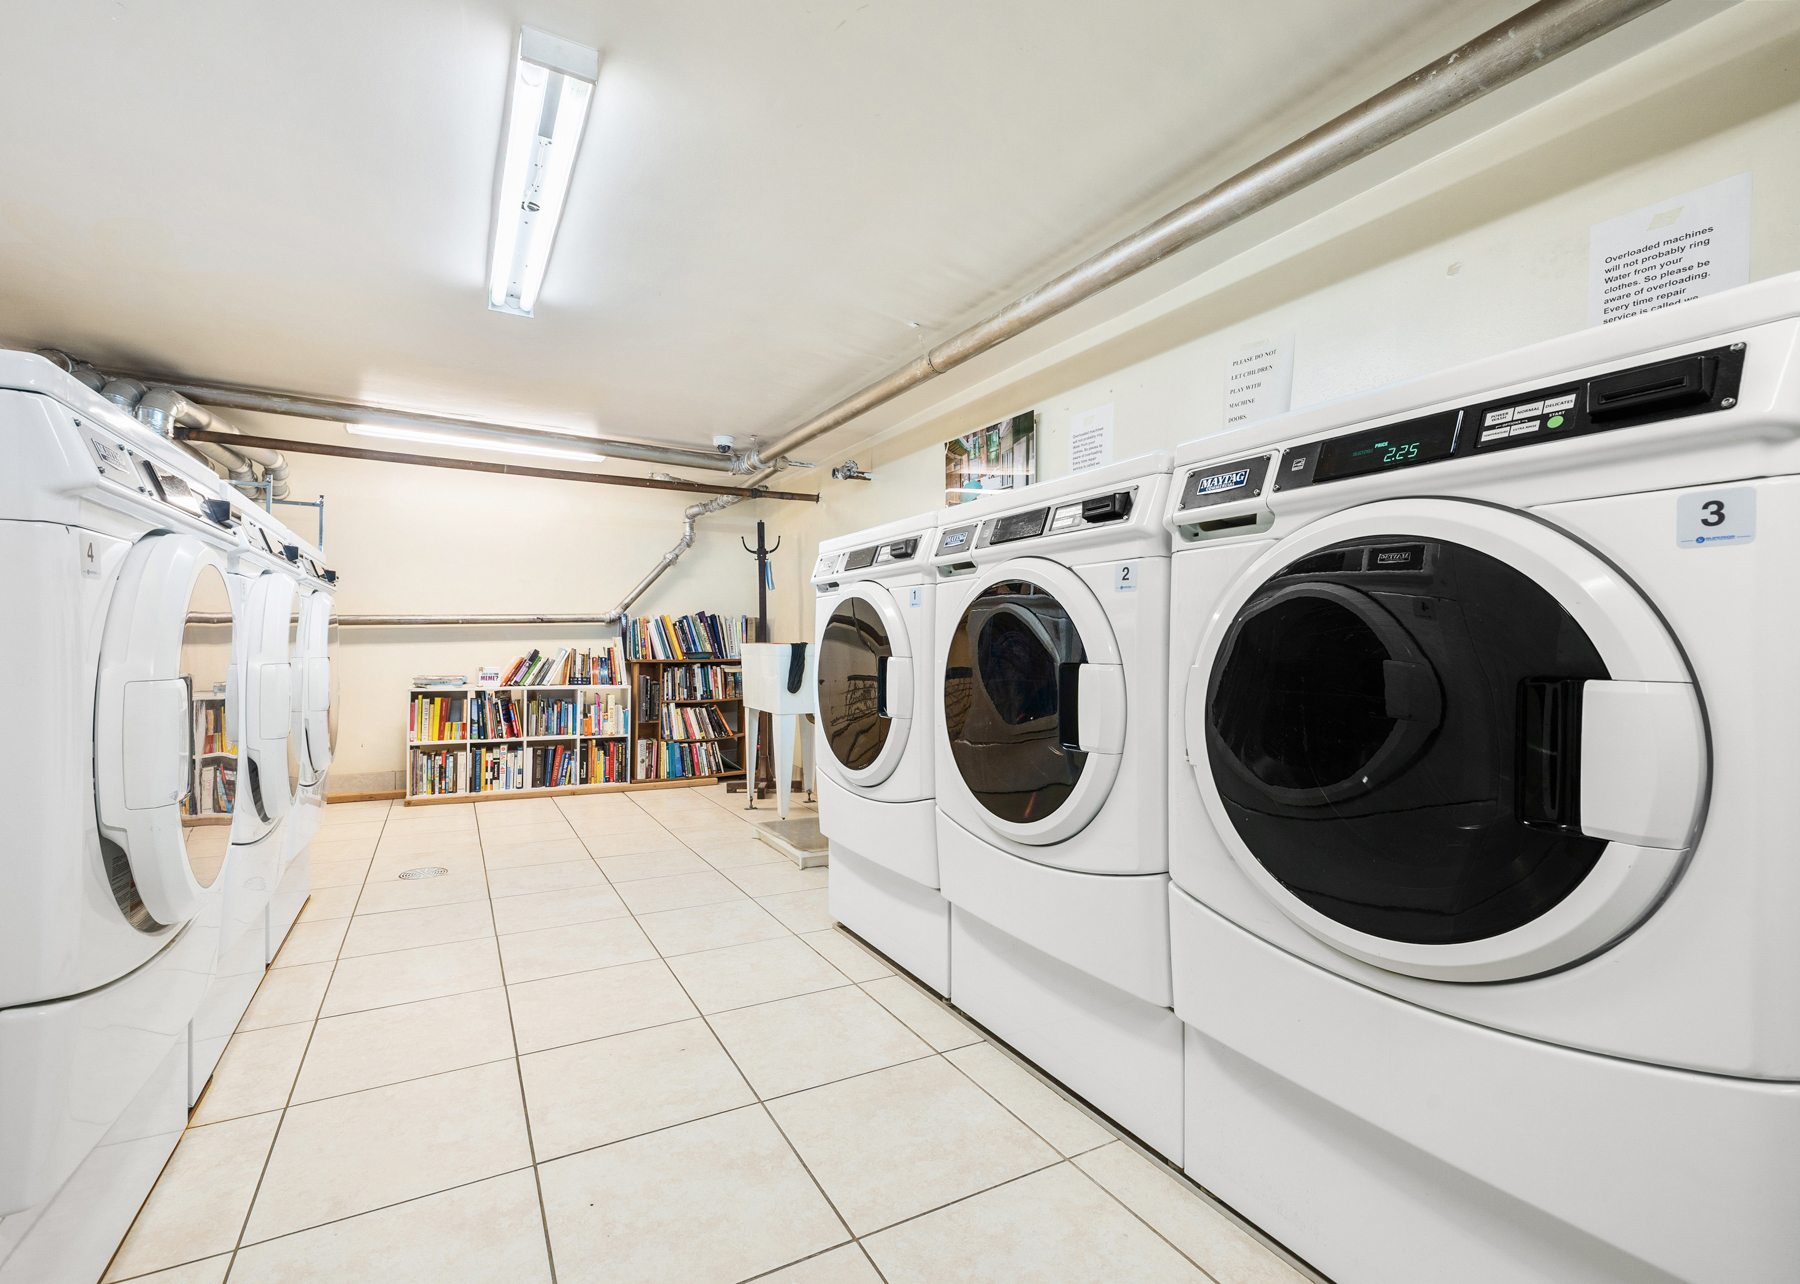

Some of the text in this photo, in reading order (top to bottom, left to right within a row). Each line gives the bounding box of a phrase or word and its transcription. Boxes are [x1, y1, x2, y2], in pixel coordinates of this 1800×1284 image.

[1604, 226, 1714, 264] Overloaded machines
[1604, 238, 1710, 274] will not probably ring
[1604, 256, 1683, 284] Water from your
[1604, 260, 1710, 294] clothes. So please be
[1604, 270, 1711, 304] aware of overloading.
[1604, 287, 1687, 315] Every time repair
[1603, 311, 1637, 324] service
[1232, 356, 1254, 366] PLEASE
[1264, 349, 1277, 357] NOT
[1242, 365, 1273, 378] CHILDREN
[1230, 382, 1262, 395] PLAY WITH
[1229, 398, 1255, 409] MACHINE
[1545, 400, 1573, 408] DELICATES
[1384, 442, 1420, 462] 2.25
[1201, 472, 1245, 489] MAYTAG
[1701, 500, 1726, 526] 3
[87, 542, 94, 562] 4
[1122, 567, 1130, 581] 2
[913, 590, 917, 600] 1
